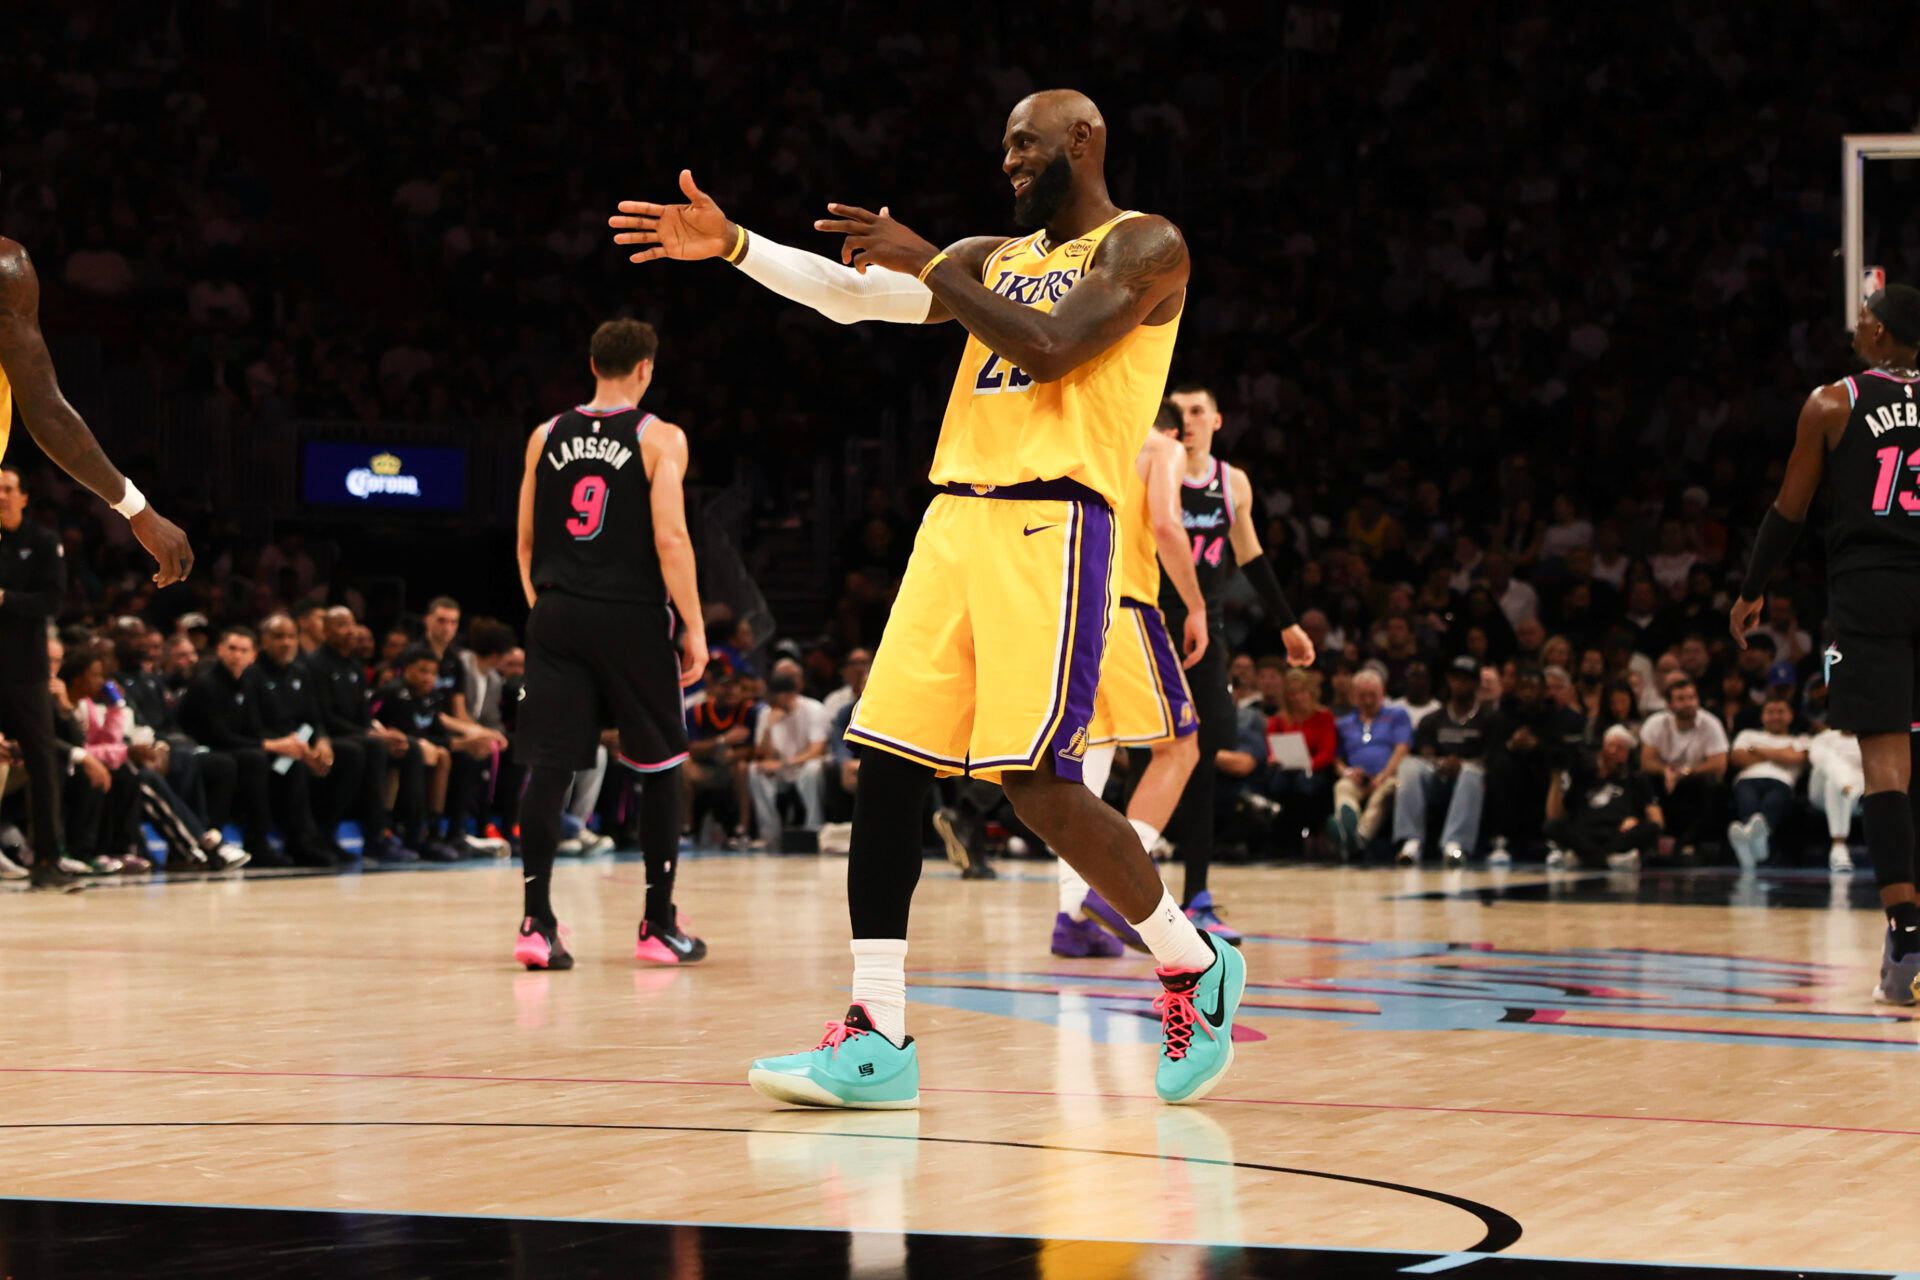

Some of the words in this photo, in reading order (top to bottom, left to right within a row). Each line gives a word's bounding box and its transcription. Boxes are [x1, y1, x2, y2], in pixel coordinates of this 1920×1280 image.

[1865, 402, 1920, 438] ADEB
[548, 437, 632, 471] LARSSON
[346, 468, 421, 499] Corona
[1871, 446, 1920, 516] 13
[566, 476, 610, 541] 9
[1192, 535, 1225, 567] 14
